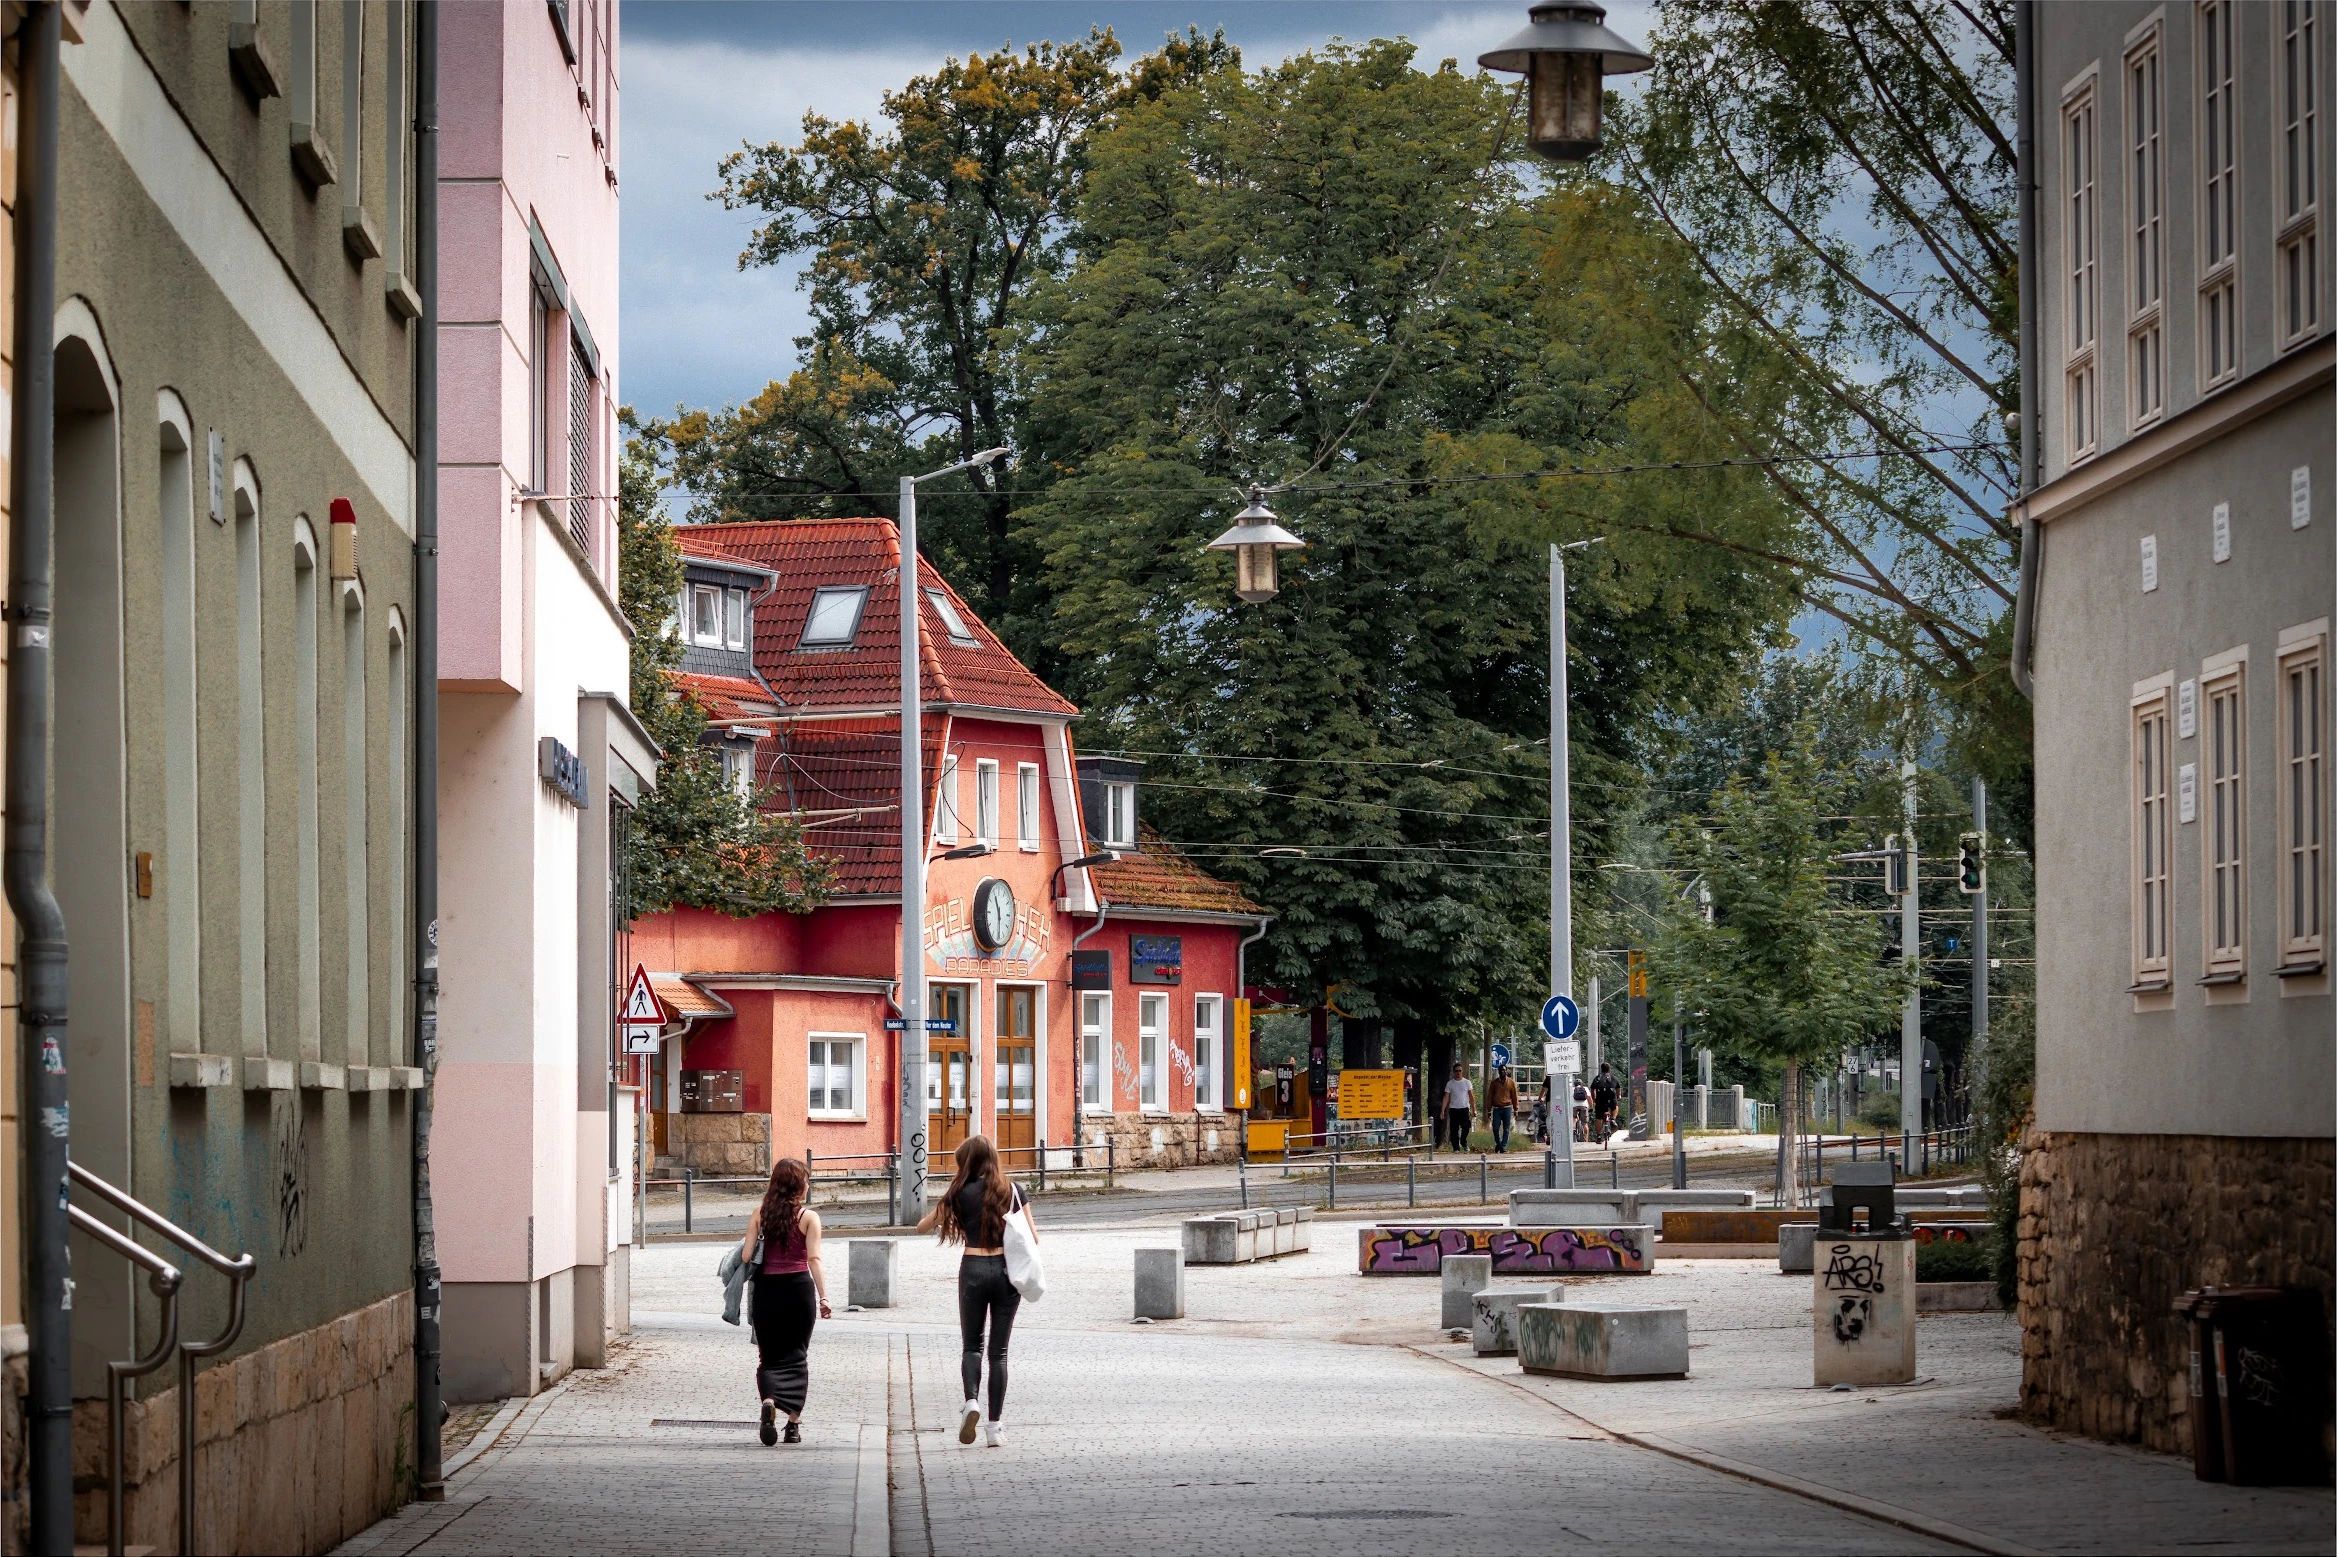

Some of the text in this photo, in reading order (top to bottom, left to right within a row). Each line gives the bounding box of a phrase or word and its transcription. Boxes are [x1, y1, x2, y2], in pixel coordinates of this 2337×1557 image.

[945, 958, 1028, 977] PARADIES
[1550, 1045, 1573, 1054] Liefer-
[1551, 1054, 1576, 1062] verkehr
[1848, 1057, 1858, 1065] 27
[1558, 1063, 1570, 1071] frei
[1850, 1065, 1856, 1073] 6
[1277, 1067, 1293, 1080] Gleis
[1281, 1080, 1290, 1103] 3
